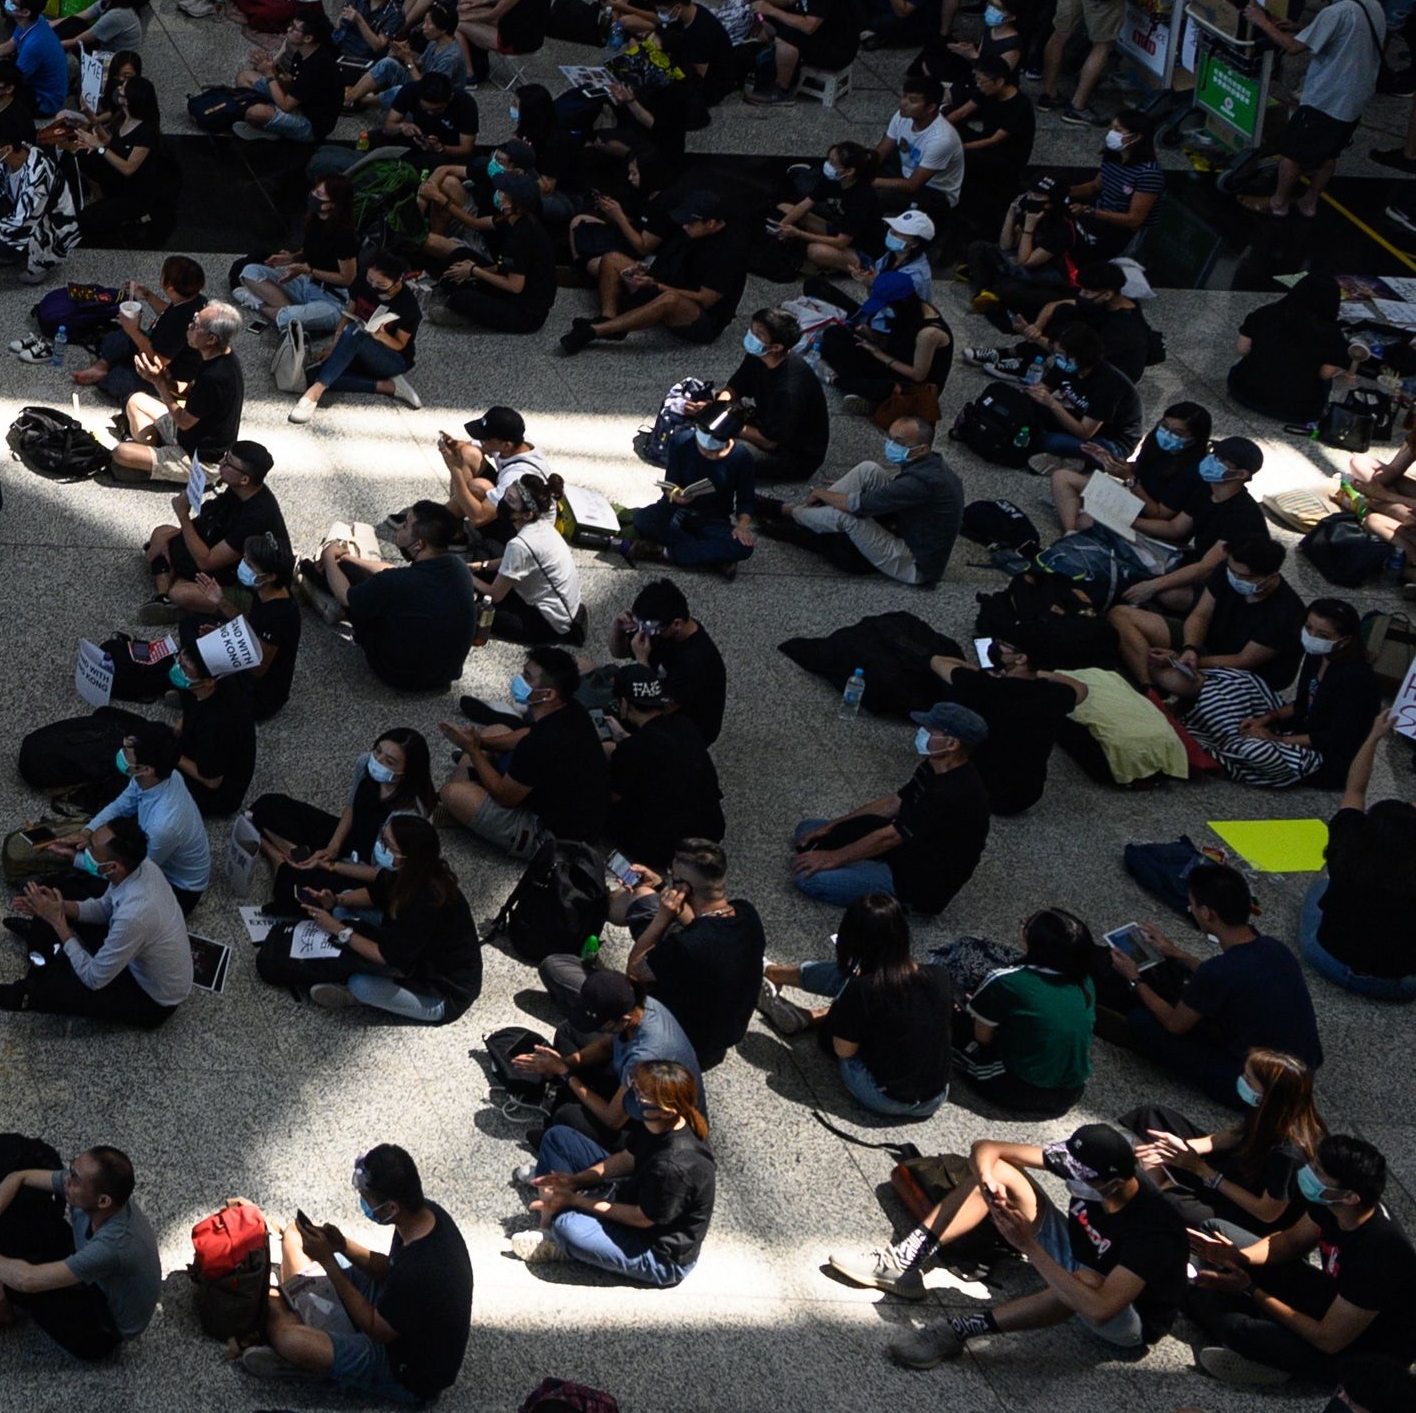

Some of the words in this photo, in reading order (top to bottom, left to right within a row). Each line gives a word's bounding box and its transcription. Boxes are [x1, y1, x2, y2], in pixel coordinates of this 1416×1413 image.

[224, 640, 242, 668] KONG
[237, 641, 253, 666] WITH
[86, 671, 108, 693] KONG
[89, 665, 110, 684] WITH
